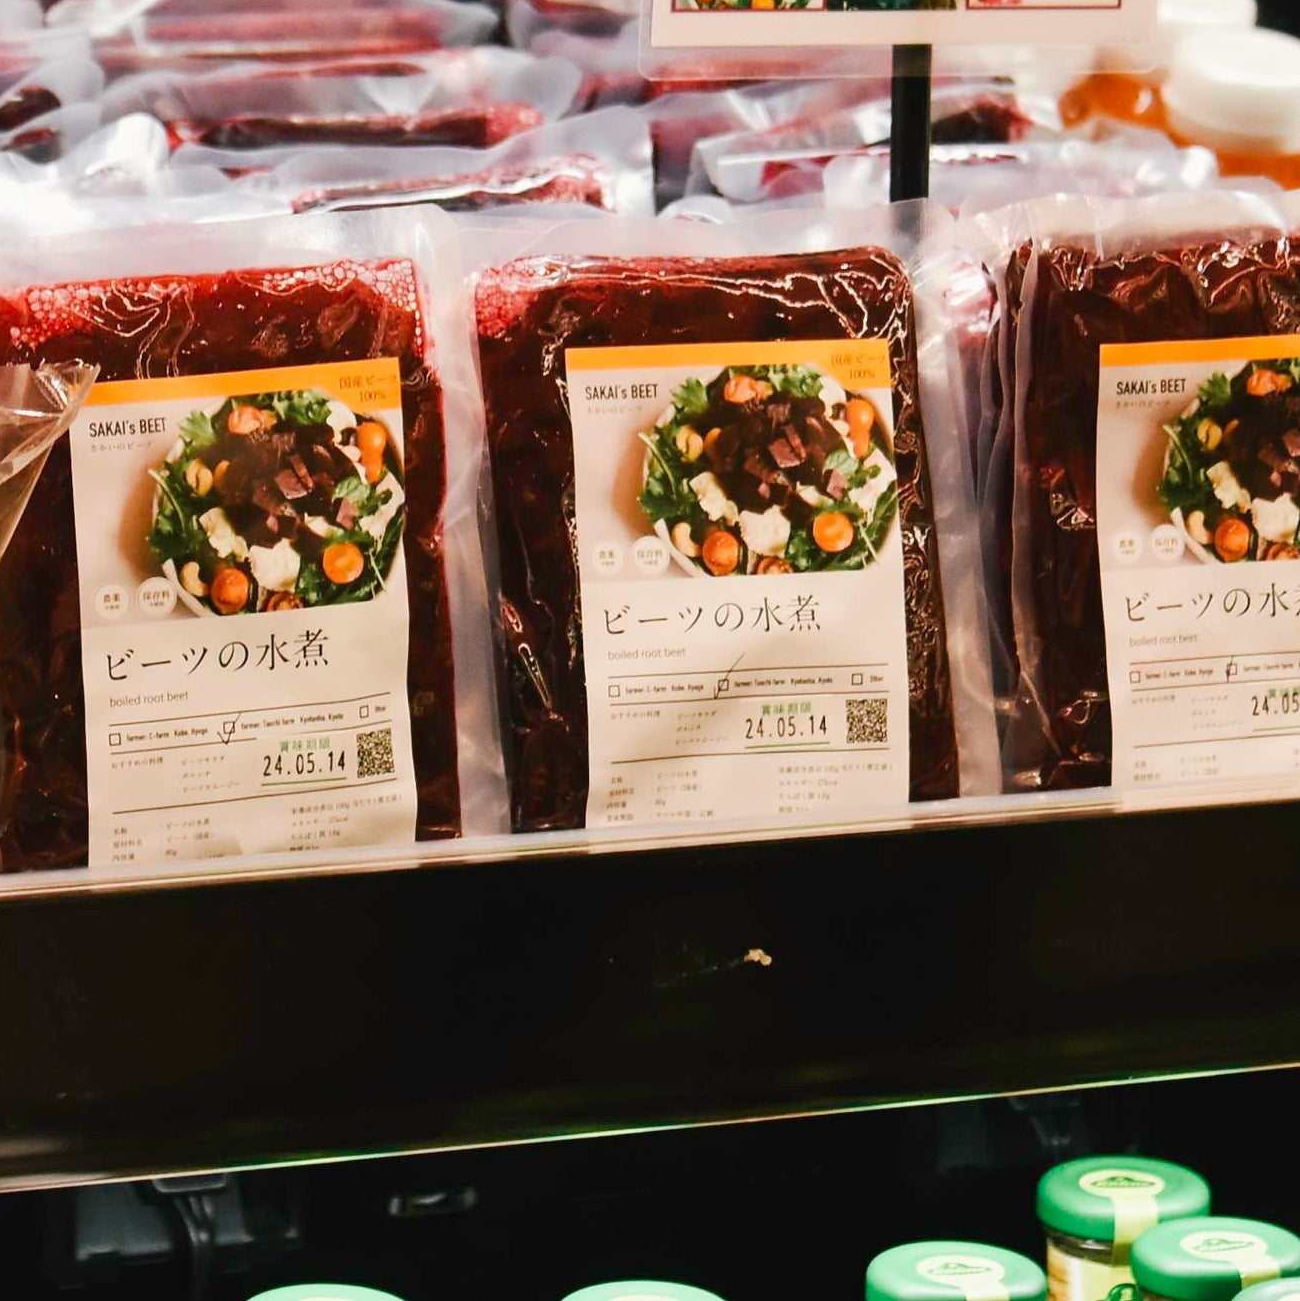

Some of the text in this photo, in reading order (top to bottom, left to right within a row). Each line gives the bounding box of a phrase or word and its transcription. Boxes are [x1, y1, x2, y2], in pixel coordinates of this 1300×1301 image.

[849, 368, 876, 380] 100%
[585, 383, 659, 401] SAKAI's BEET
[1160, 378, 1187, 394] BEET
[359, 390, 387, 404] 100%
[89, 417, 168, 438] SAKAI's BEET
[602, 594, 821, 637] ビーツの水煮
[1159, 634, 1178, 645] root
[1178, 632, 1198, 644] beet
[106, 628, 330, 683] ビーツの水煮
[608, 647, 686, 661] boiled root beet
[109, 691, 189, 708] boiled root beet
[745, 714, 828, 740] 24.05.14
[263, 751, 346, 777] 24.05.14
